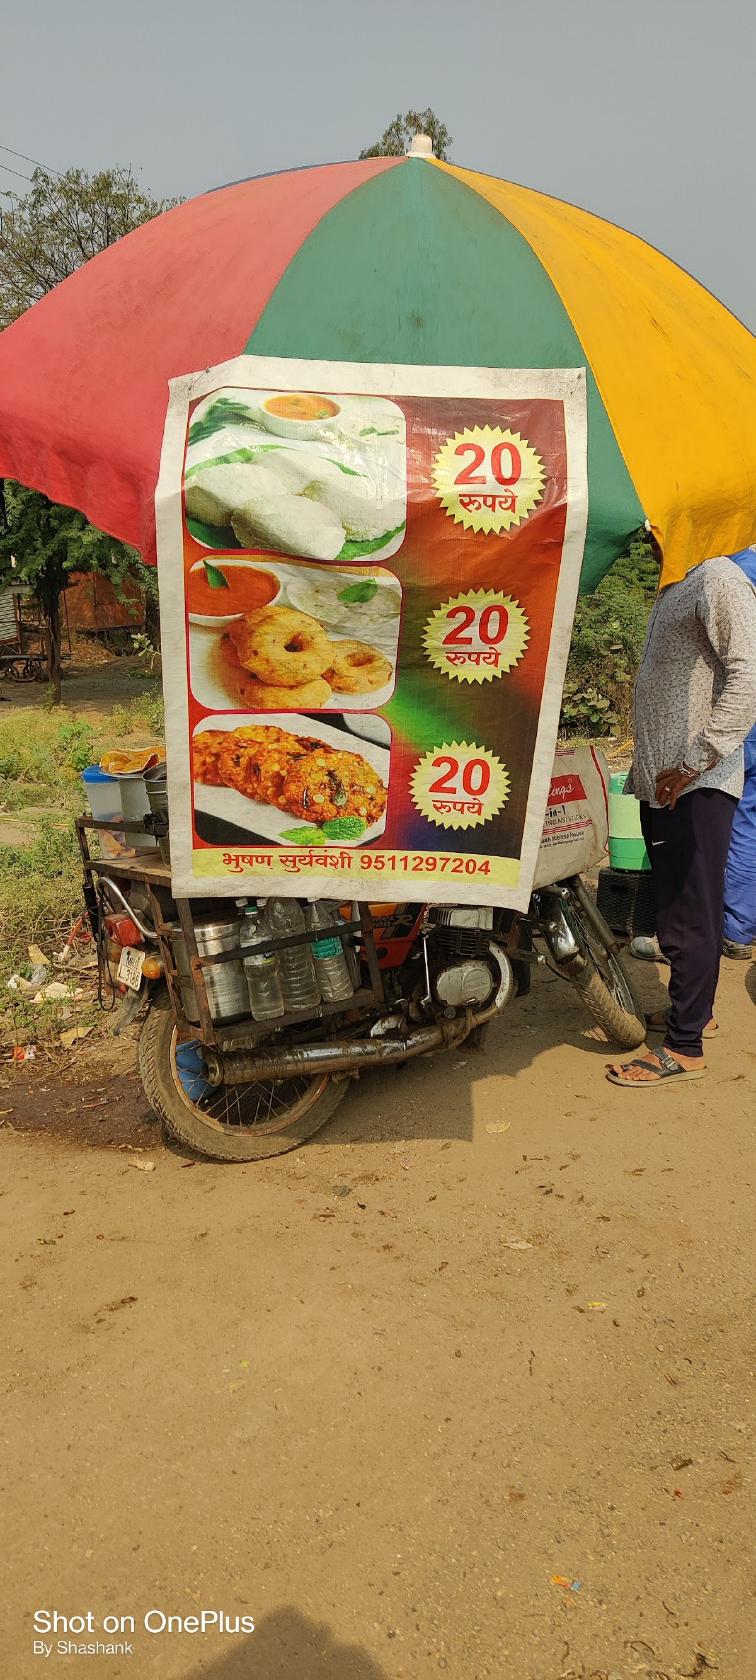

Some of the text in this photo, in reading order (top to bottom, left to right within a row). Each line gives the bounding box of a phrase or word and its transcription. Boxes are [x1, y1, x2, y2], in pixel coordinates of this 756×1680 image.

[454, 442, 522, 487] 20
[442, 604, 509, 646] 20
[428, 756, 491, 797] 20
[545, 805, 566, 817] -in-1
[279, 849, 353, 873] सुर्यवंशी
[360, 854, 491, 876] 9511297204
